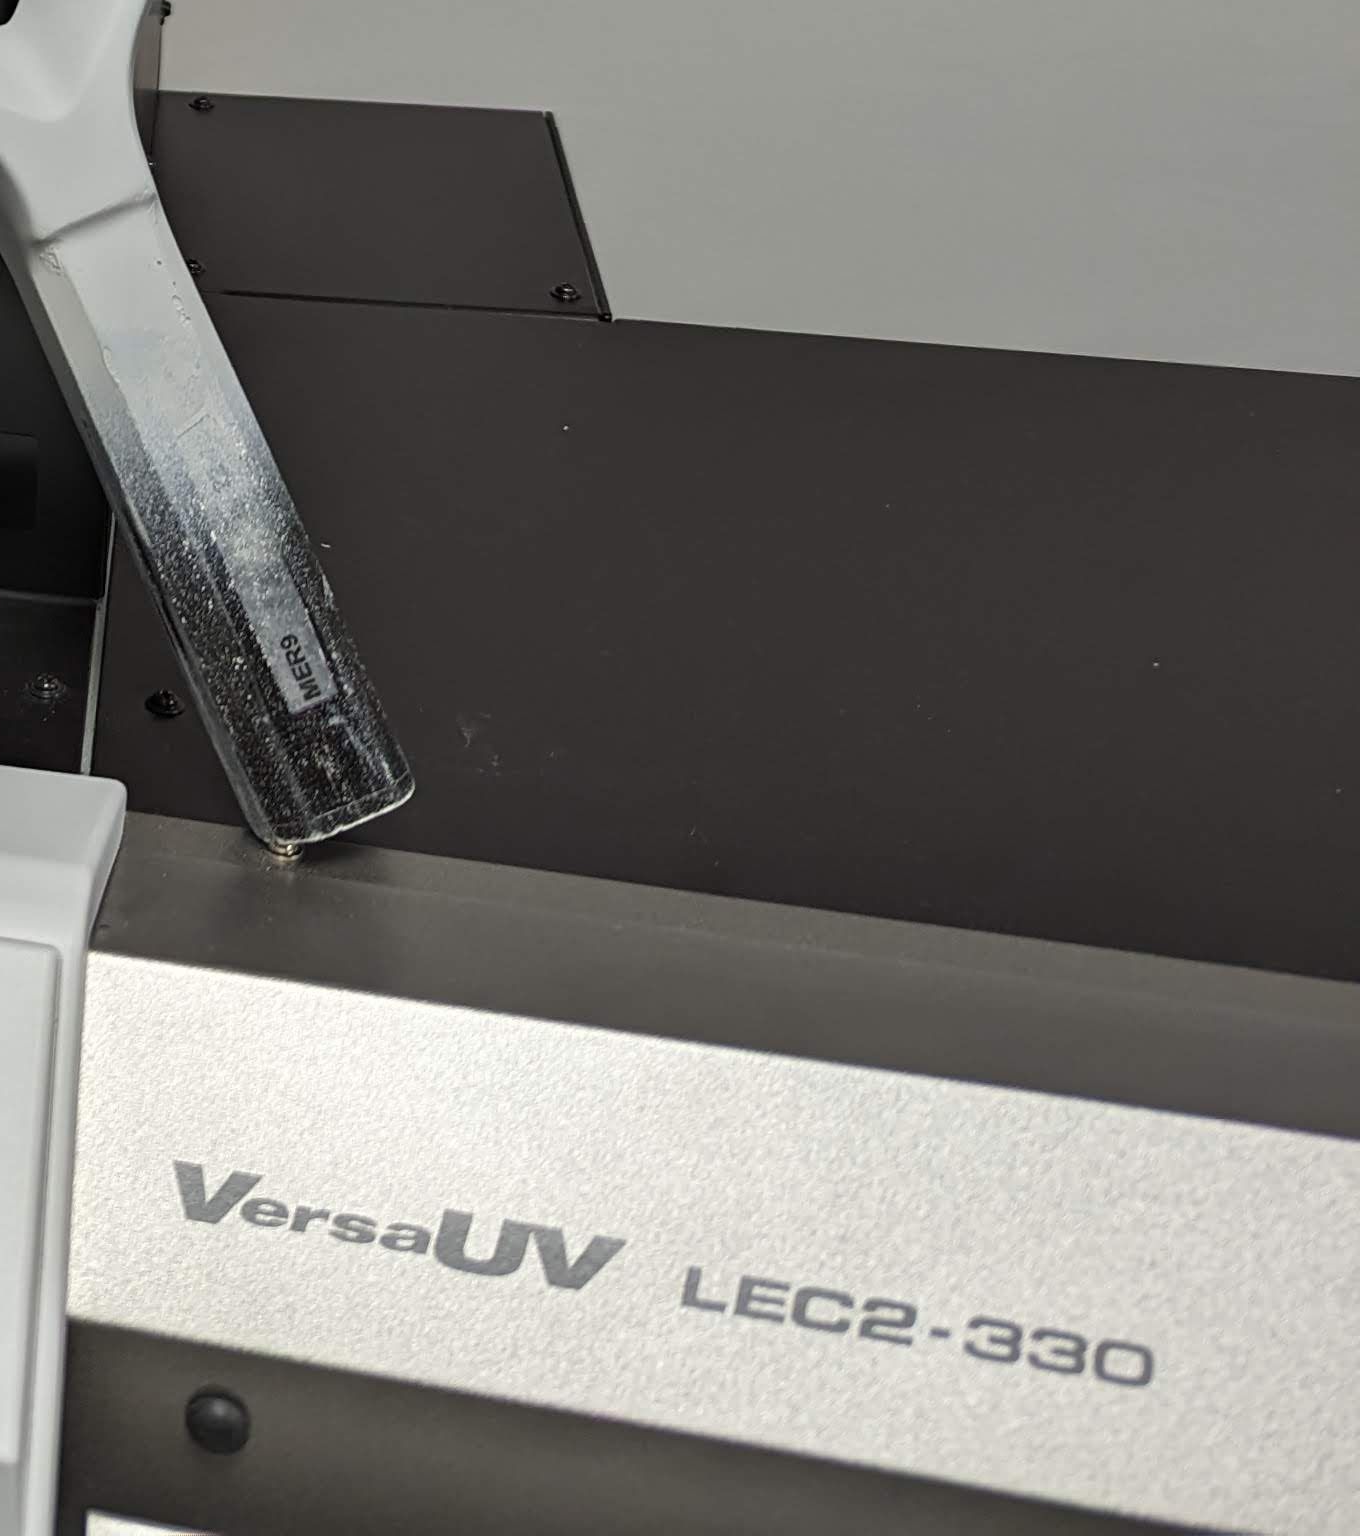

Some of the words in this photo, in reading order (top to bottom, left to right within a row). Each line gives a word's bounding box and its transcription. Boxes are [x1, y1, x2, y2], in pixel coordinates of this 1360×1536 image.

[280, 634, 321, 701] MER9
[172, 1160, 627, 1292] VersaUV
[681, 1267, 1155, 1388] LEC2-330
